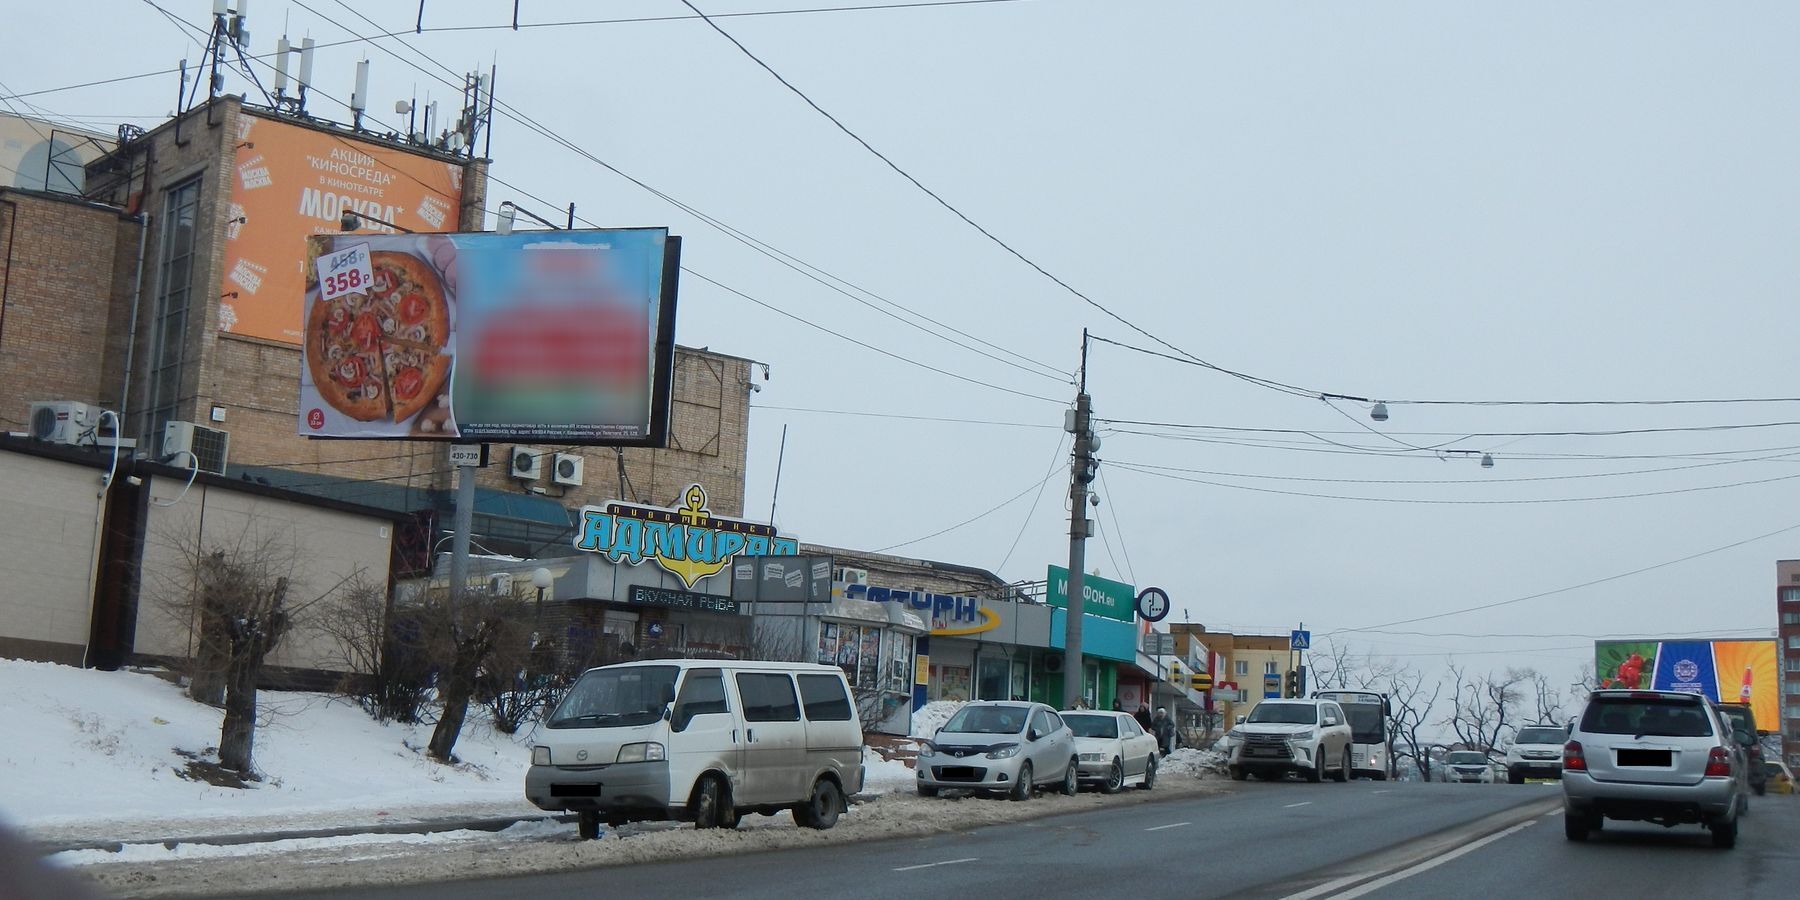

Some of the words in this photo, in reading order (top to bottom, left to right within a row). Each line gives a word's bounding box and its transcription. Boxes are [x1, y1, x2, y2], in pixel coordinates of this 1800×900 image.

[330, 147, 375, 168] АКЦИЯ
[306, 154, 397, 185] "КИНОСРЕДА"
[319, 175, 326, 185] В
[327, 177, 385, 198] КИНОТЕАТРЕ
[452, 452, 479, 460] 430-730
[635, 588, 693, 607] ВКУСНАЯ
[699, 596, 736, 612] РЫБА
